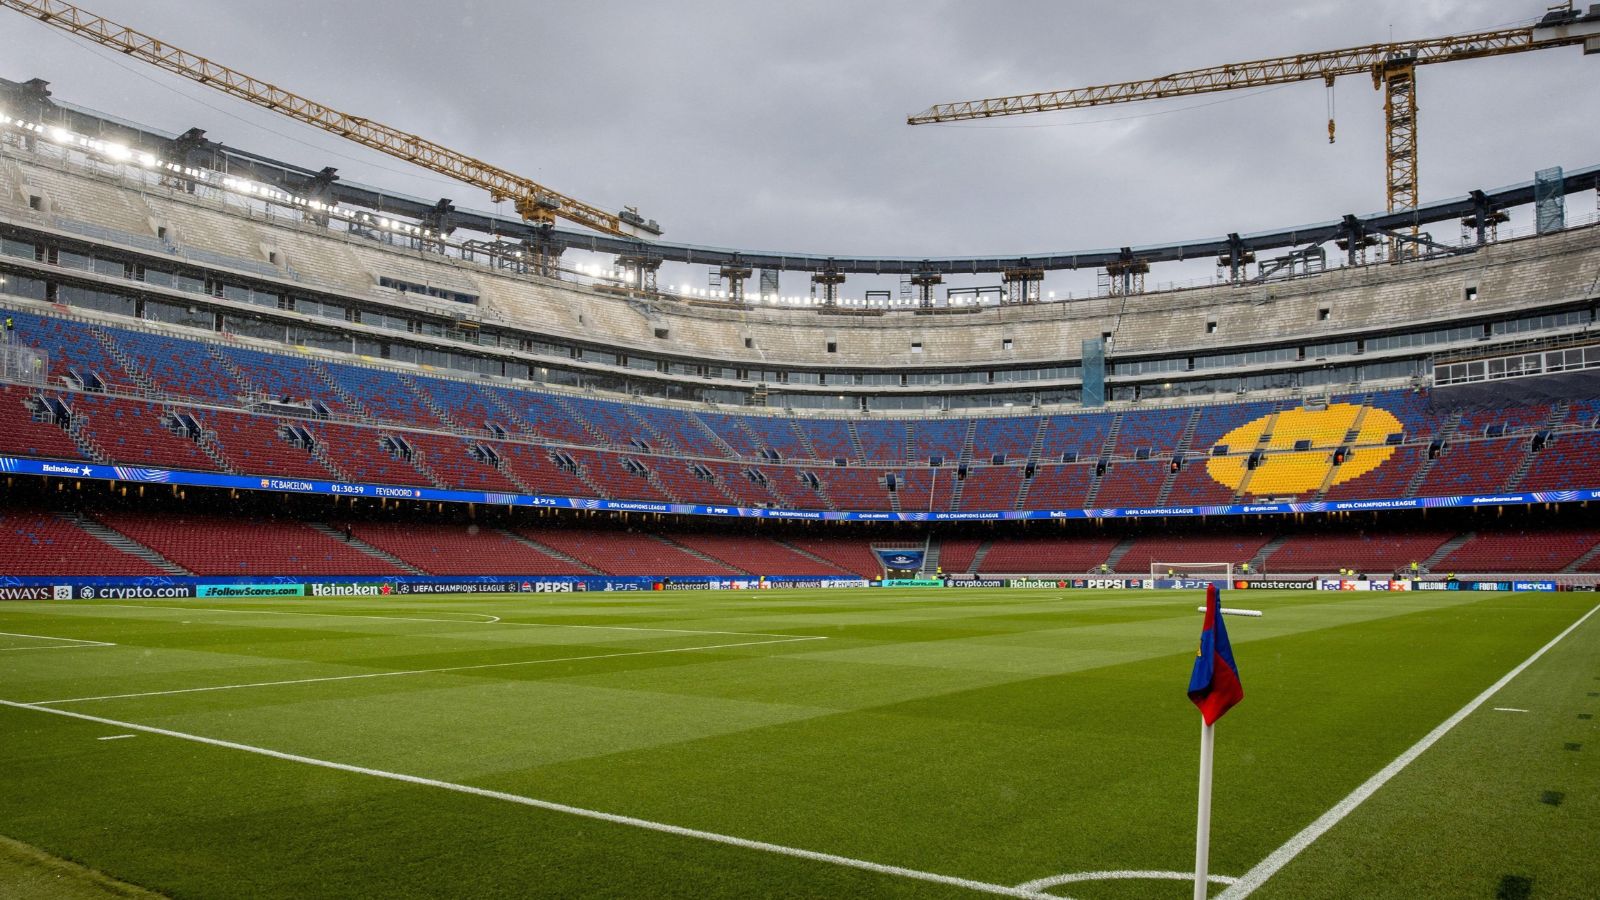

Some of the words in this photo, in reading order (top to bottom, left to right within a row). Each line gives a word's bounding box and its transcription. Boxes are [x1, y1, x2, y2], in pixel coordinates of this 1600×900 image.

[42, 464, 80, 474] Heineken
[271, 480, 278, 488] FC
[279, 481, 312, 490] BARCELONA
[332, 484, 364, 494] 01:30:59
[376, 488, 412, 497] FEYENOORD
[536, 582, 573, 592] PEPSI
[1010, 580, 1056, 588] Heineken
[1088, 580, 1126, 589] PEPSI
[1250, 581, 1314, 589] mastercard
[1322, 580, 1357, 590] FedEx
[1370, 580, 1406, 590] FedEx
[100, 586, 189, 598] crypto.com
[312, 584, 378, 596] Heineken
